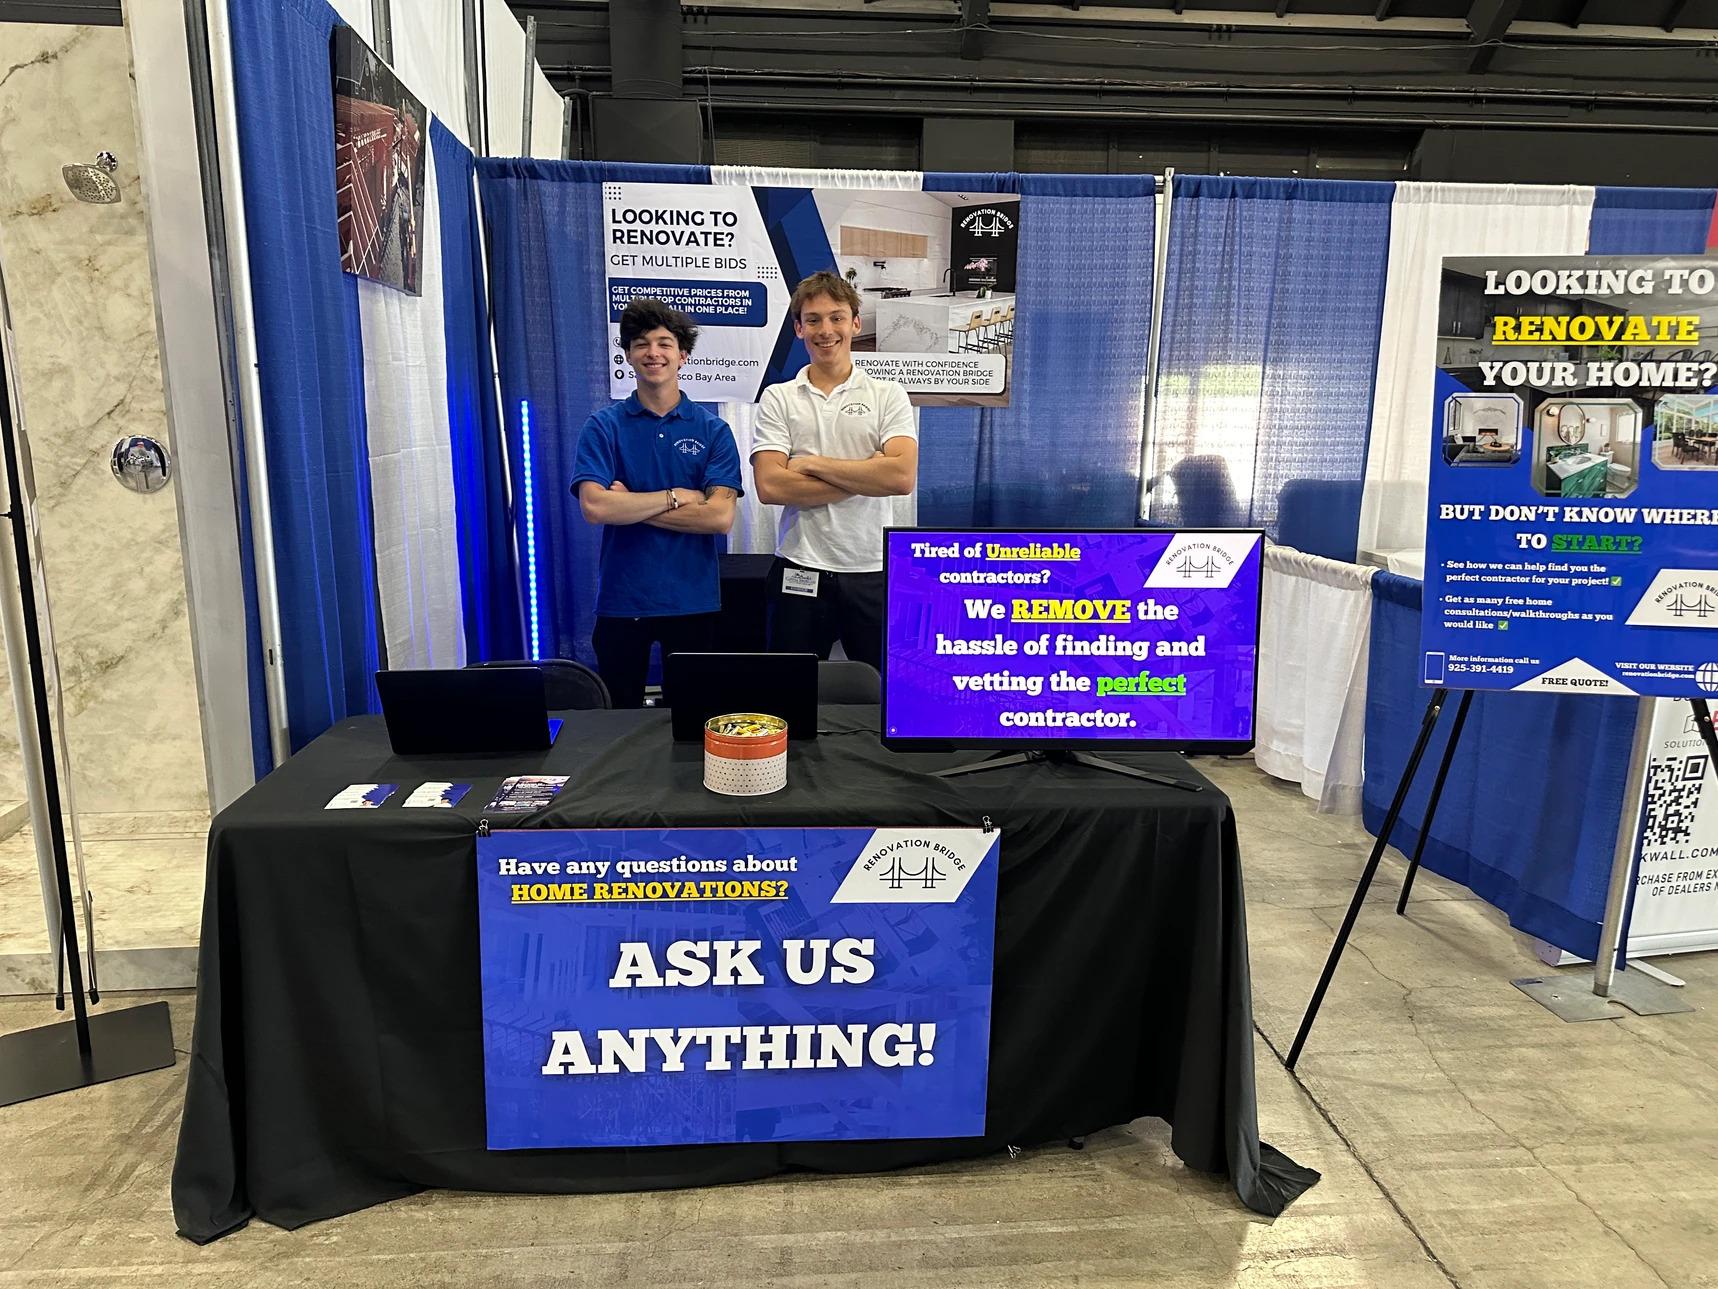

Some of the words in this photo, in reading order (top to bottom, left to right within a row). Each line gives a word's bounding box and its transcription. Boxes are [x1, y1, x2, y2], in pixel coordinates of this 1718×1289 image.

[612, 208, 705, 226] LOOKING
[710, 211, 737, 227] TO
[960, 209, 996, 228] RENOVATION
[996, 211, 1014, 229] BRIDGE
[612, 229, 735, 248] RENOVATE?
[610, 254, 638, 266] GET
[642, 255, 710, 269] MULTIPLE
[714, 258, 747, 269] BIDS
[1484, 270, 1655, 295] LOOKING
[1664, 269, 1715, 294] TO
[612, 286, 629, 294] GET
[630, 287, 690, 295] COMPETITIVE
[691, 288, 722, 297] PRICES
[724, 290, 749, 298] FROM
[675, 297, 741, 306] CONTRACTORS
[742, 298, 752, 306] IN
[685, 305, 694, 313] IN
[717, 306, 747, 315] PLACE!
[1492, 316, 1700, 342] RENOVATE
[902, 360, 924, 368] WITH
[695, 373, 712, 382] Bay
[714, 374, 736, 382] Area
[865, 368, 896, 376] OWING
[1479, 361, 1577, 386] YOUR
[1585, 361, 1717, 387] HOME?
[898, 377, 932, 385] ALWAYS
[1439, 504, 1485, 520] BUT
[1563, 507, 1638, 523] KNOW
[1516, 533, 1547, 549] TO
[1552, 535, 1643, 552] START?
[911, 543, 960, 559] Tired
[964, 542, 982, 559] of
[986, 543, 1080, 559] Unreliable
[1166, 543, 1210, 565] RENOVATION
[1212, 546, 1234, 566] BRIDGE
[1447, 560, 1464, 569] See
[1466, 561, 1487, 570] how
[1524, 562, 1546, 572] help
[1548, 563, 1568, 572] find
[1569, 565, 1588, 574] you
[1590, 564, 1606, 573] the
[939, 570, 1051, 584] contractors?
[1446, 574, 1480, 583] perfect
[1481, 575, 1530, 584] contractor
[1532, 575, 1546, 584] for
[1547, 577, 1570, 586] your
[1571, 577, 1609, 586] project!
[1655, 581, 1703, 603] RENOVATION
[1445, 595, 1462, 603] Get
[1477, 597, 1503, 606] many
[1505, 596, 1524, 605] free
[1526, 597, 1552, 606] home
[964, 599, 1005, 620] We
[1012, 600, 1131, 621] REMOVE
[1137, 600, 1178, 620] the
[1444, 608, 1579, 620] consultations/walkthroughs
[1594, 613, 1613, 622] you
[1444, 620, 1473, 629] would
[1475, 621, 1494, 629] like
[936, 634, 1018, 656] hassle
[1023, 634, 1050, 656] of
[1055, 635, 1150, 660] finding
[1156, 636, 1206, 657] and
[1470, 655, 1513, 664] information
[1515, 656, 1529, 664] call
[1448, 663, 1514, 674] 925-391-4419
[1622, 671, 1695, 679] renovationbridge.com
[952, 670, 1043, 695] vetting
[1050, 671, 1091, 692] the
[1097, 671, 1186, 696] perfect
[1541, 677, 1568, 686] FREE
[1570, 678, 1609, 687] QUOTE!
[1000, 709, 1136, 728] contractor.
[1664, 740, 1704, 749] SOLUTIO
[863, 839, 931, 872] RENOVATION
[933, 843, 966, 872] BRIDGE
[498, 858, 563, 876] Have
[566, 861, 609, 879] any
[615, 855, 727, 879] questions
[733, 855, 798, 873] about
[1676, 870, 1704, 882] FROM
[511, 883, 587, 901] HOME
[598, 880, 789, 900] RENOVATIONS?
[1652, 886, 1665, 897] OF
[1668, 882, 1712, 895] DEALERS
[608, 940, 764, 988] ASK
[783, 938, 875, 985] US
[541, 1023, 936, 1075] ANYTHING!
